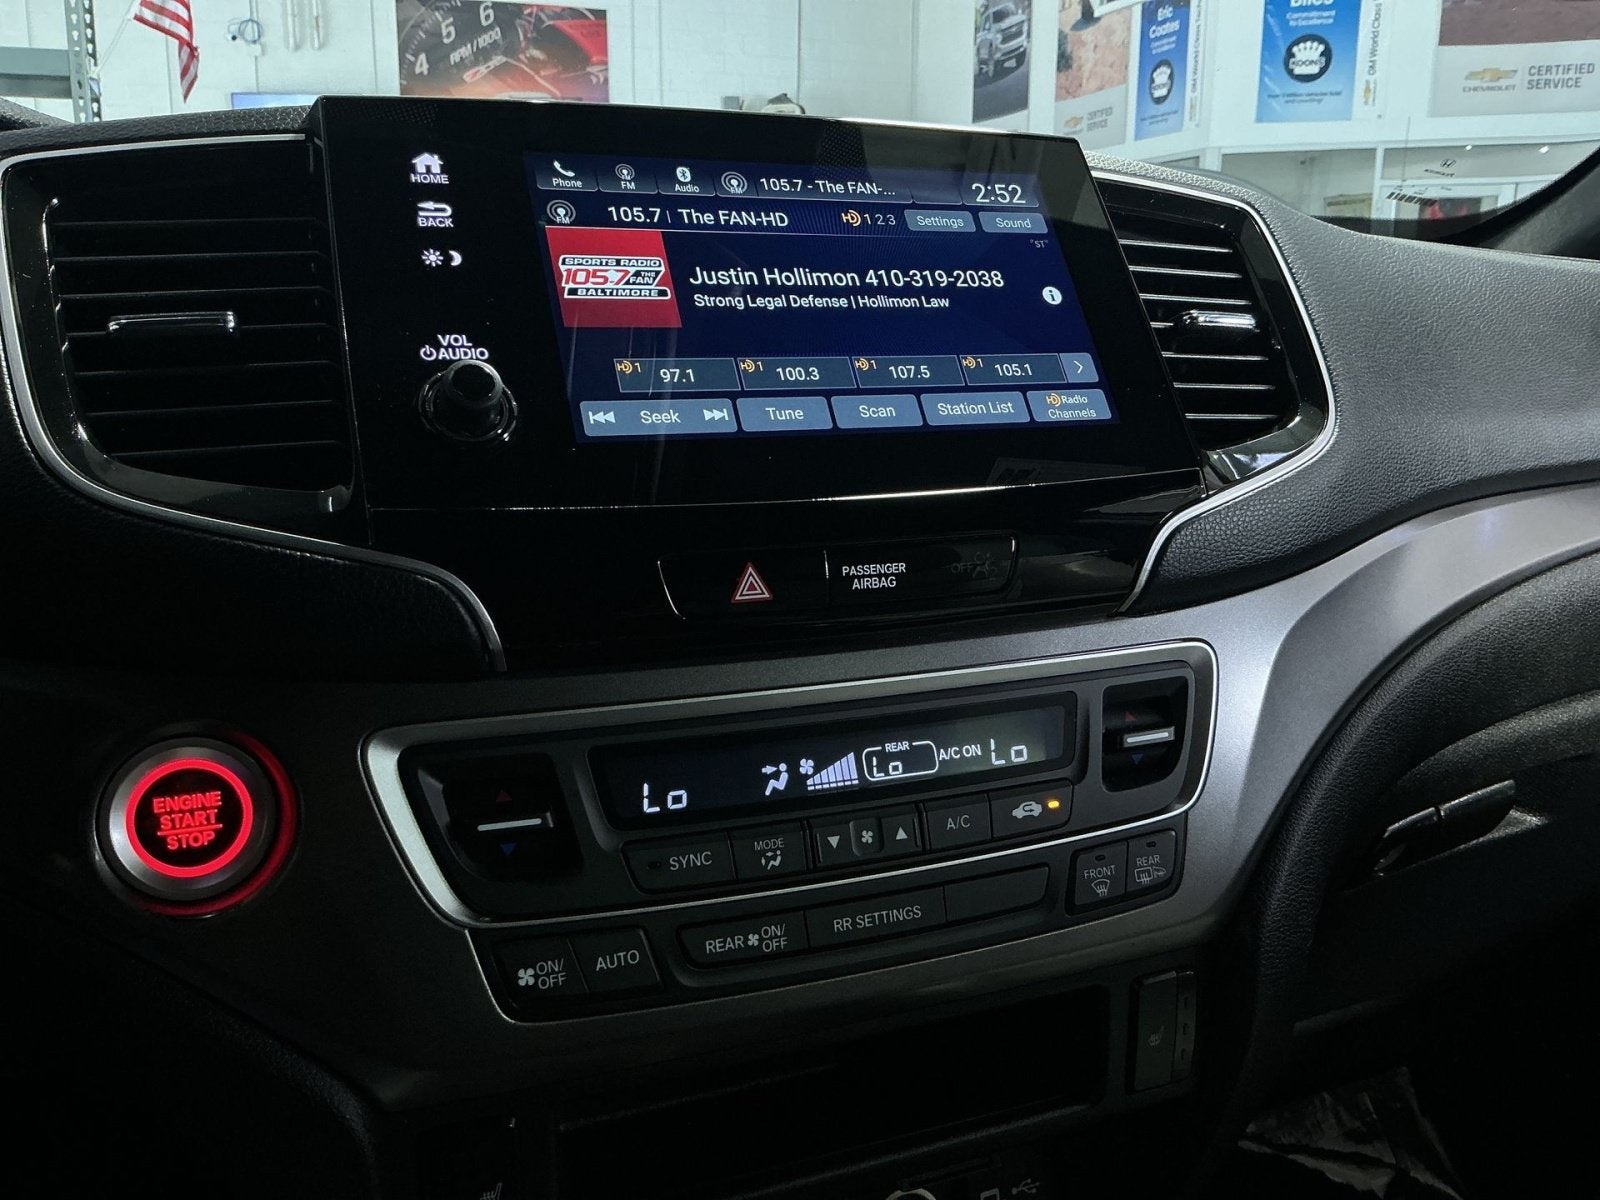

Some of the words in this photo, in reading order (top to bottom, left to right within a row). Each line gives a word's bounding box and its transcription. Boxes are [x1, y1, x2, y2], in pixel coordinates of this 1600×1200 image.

[480, 2, 495, 26] 6
[1372, 3, 1382, 29] Class
[441, 16, 456, 44] 5
[1369, 30, 1380, 58] World
[414, 52, 430, 75] 4
[1528, 62, 1596, 77] CERTIFIED
[1526, 76, 1583, 90] SERVICE
[411, 173, 449, 184] HOME
[552, 178, 582, 188] Phone
[621, 181, 636, 190] FM
[760, 177, 802, 192] 105.7
[815, 180, 845, 194] The
[674, 183, 700, 193] Audio
[971, 183, 1026, 204] 2:52
[418, 217, 454, 228] BACK
[607, 206, 661, 223] 105.7
[677, 208, 715, 224] The
[719, 210, 788, 227] FAN-HD
[916, 215, 964, 228] Settings
[995, 217, 1031, 229] Sound
[565, 258, 616, 266] SPORTS
[620, 259, 660, 267] RADIO
[563, 268, 631, 286] 105.7
[629, 276, 653, 284] FAN
[689, 267, 759, 285] Justin
[763, 267, 860, 286] Hollimon
[865, 269, 1005, 288] 410-319-2038
[577, 288, 659, 297] BALTIMORE
[693, 294, 745, 310] Strong
[747, 294, 787, 310] Legal
[789, 294, 849, 307] Defense
[858, 295, 920, 308] Hollimon
[923, 296, 949, 308] Law
[437, 334, 473, 346] VOL
[438, 348, 489, 360] AUDIO
[659, 368, 695, 383] 97.1
[776, 367, 820, 382] 100.3
[888, 365, 930, 379] 107.5
[994, 363, 1033, 377] 105.1
[1062, 395, 1088, 404] Radio
[765, 407, 804, 421] Tune
[859, 405, 896, 418] Scan
[937, 402, 987, 416] Station
[990, 401, 1015, 414] List
[1048, 408, 1096, 419] Channels
[640, 409, 681, 424] Seek
[842, 562, 906, 577] PASSENGER
[852, 576, 897, 590] AIRBAG
[885, 741, 910, 752] REAR
[938, 747, 961, 761] A/C
[962, 744, 982, 758] ON
[153, 791, 222, 813] ENGINE
[160, 809, 218, 830] START
[946, 815, 971, 831] A/C
[167, 831, 215, 850] STOP
[754, 837, 785, 851] MODE
[669, 851, 713, 871] SYNC
[1136, 855, 1161, 867] REAR
[1083, 865, 1116, 879] FRONT
[833, 917, 853, 933] RR
[856, 905, 922, 929] SETTINGS
[761, 923, 786, 939] ON/
[705, 935, 744, 954] REAR
[762, 937, 788, 953] OFF
[536, 958, 564, 975] ON/
[596, 949, 640, 972] AUTO
[538, 972, 567, 989] OFF
